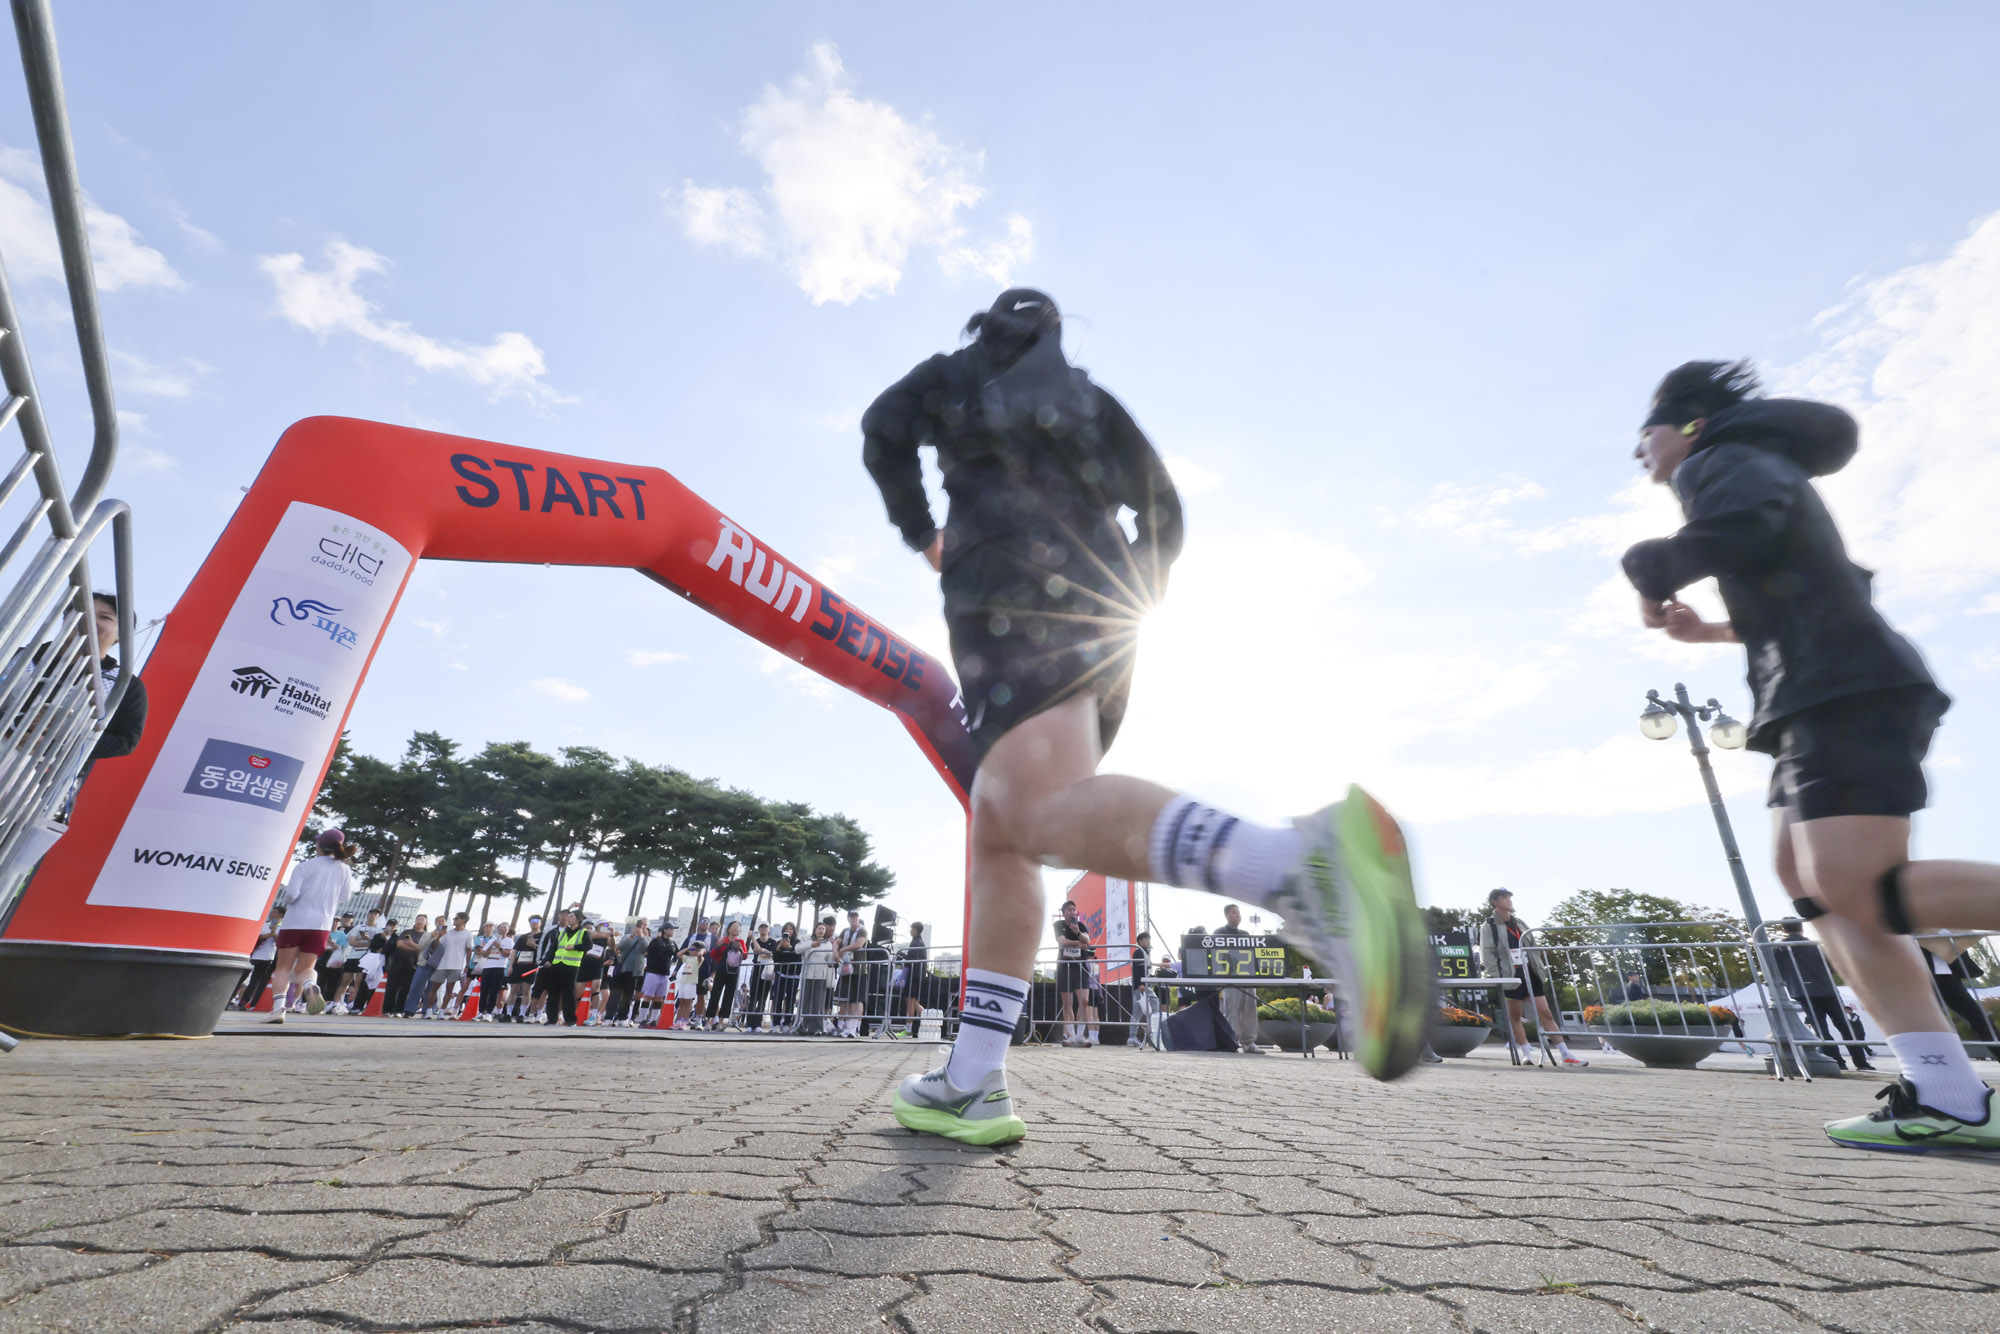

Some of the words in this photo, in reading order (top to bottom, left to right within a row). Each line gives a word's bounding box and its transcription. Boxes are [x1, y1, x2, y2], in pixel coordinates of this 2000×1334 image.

[450, 453, 647, 521] START
[311, 555, 349, 575] daddy
[350, 569, 374, 586] food
[311, 615, 358, 651] 피죤
[274, 704, 294, 716] Korea
[278, 696, 291, 706] for
[293, 701, 327, 720] Humanity
[281, 683, 332, 713] Habitat
[200, 765, 289, 803] 동원샘물
[134, 848, 225, 873] WOMAN
[226, 860, 271, 881] SENSE
[1214, 937, 1267, 947] SAMIK
[1260, 949, 1279, 957] 5km
[1440, 946, 1465, 955] 10km
[965, 995, 1003, 1013] FILA
